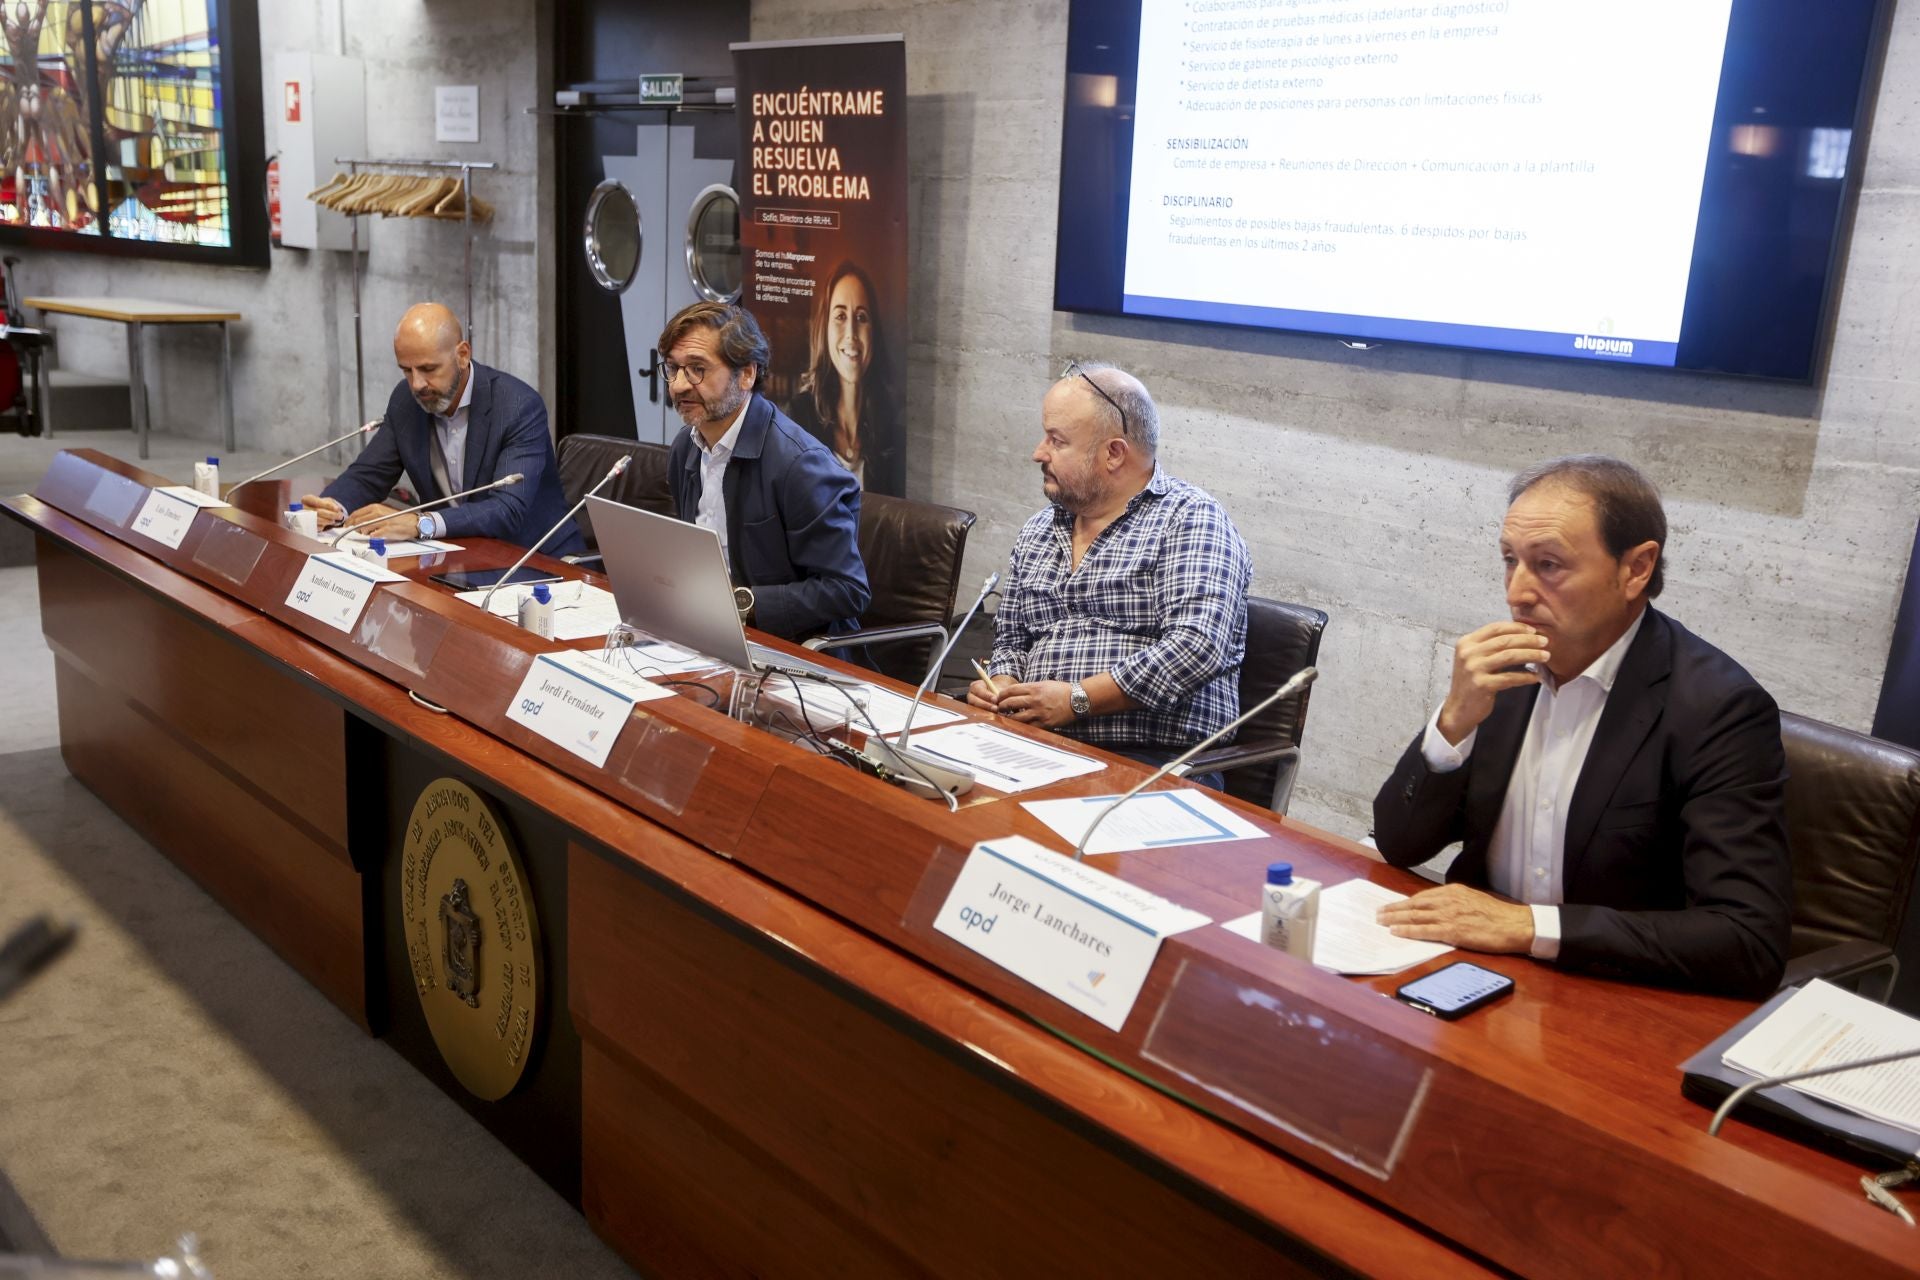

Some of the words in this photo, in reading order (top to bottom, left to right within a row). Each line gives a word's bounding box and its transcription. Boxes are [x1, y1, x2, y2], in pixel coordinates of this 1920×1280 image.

[1256, 17, 1269, 29] de
[1272, 14, 1316, 28] pruebas
[1189, 39, 1227, 52] Servicio
[1230, 38, 1243, 50] de
[1245, 36, 1303, 49] fisioterapia
[1305, 34, 1320, 46] de
[1323, 32, 1352, 45] lunes
[1355, 34, 1362, 43] a
[1365, 29, 1407, 43] viernes
[1410, 29, 1426, 41] en
[1429, 26, 1440, 40] la
[1443, 25, 1499, 40] empresa
[1188, 60, 1226, 72] Servicio
[1228, 59, 1241, 71] de
[1243, 57, 1288, 72] gabinete
[1353, 53, 1399, 65] externo
[641, 80, 681, 97] SALIDA
[1186, 80, 1224, 91] Servicio
[1227, 79, 1239, 90] de
[1241, 77, 1280, 90] dietista
[1282, 77, 1324, 89] externo
[752, 86, 883, 116] ENCUÉNTRAME
[1186, 99, 1242, 112] Adecuación
[1244, 98, 1257, 111] de
[1259, 98, 1315, 113] posiciones
[1317, 98, 1342, 112] para
[1345, 96, 1396, 111] personas
[1399, 96, 1421, 107] con
[1424, 91, 1499, 106] limitaciones
[753, 120, 764, 142] A
[769, 120, 823, 144] QUIEN
[1166, 137, 1249, 150] SENSIBILIZACIÓN
[753, 147, 840, 171] RESUELVA
[1173, 157, 1207, 169] Comité
[1209, 158, 1221, 169] de
[1224, 159, 1267, 172] empresa
[1279, 158, 1334, 171] Reuniones
[1337, 158, 1351, 171] de
[1513, 162, 1520, 173] a
[1524, 159, 1536, 173] la
[1540, 160, 1596, 175] plantilla
[753, 174, 772, 195] EL
[778, 174, 870, 200] PROBLEMA
[1163, 194, 1234, 208] DISCIPLINARIO
[779, 213, 803, 224] Directora
[804, 216, 812, 224] de
[1169, 214, 1233, 229] Seguimientos
[1235, 217, 1248, 229] de
[1250, 217, 1291, 232] posibles
[1294, 218, 1322, 234] bajas
[1401, 224, 1408, 236] 6
[1411, 223, 1465, 239] despidos
[1468, 226, 1490, 240] por
[1494, 226, 1528, 242] bajas
[1168, 232, 1227, 248] fraudulentas
[1229, 237, 1242, 248] en
[1245, 236, 1258, 249] los
[1301, 239, 1309, 252] 2
[1311, 240, 1337, 253] años
[755, 249, 774, 259] Somos
[755, 260, 763, 268] de
[764, 260, 770, 268] tu
[311, 574, 331, 589] Andoni
[296, 590, 313, 604] apd
[521, 697, 545, 716] apd
[540, 679, 561, 698] Jordi
[562, 689, 604, 720] Fernández
[960, 905, 998, 934] apd
[989, 882, 1031, 913] Jorge
[1034, 905, 1112, 957] Lanchares
